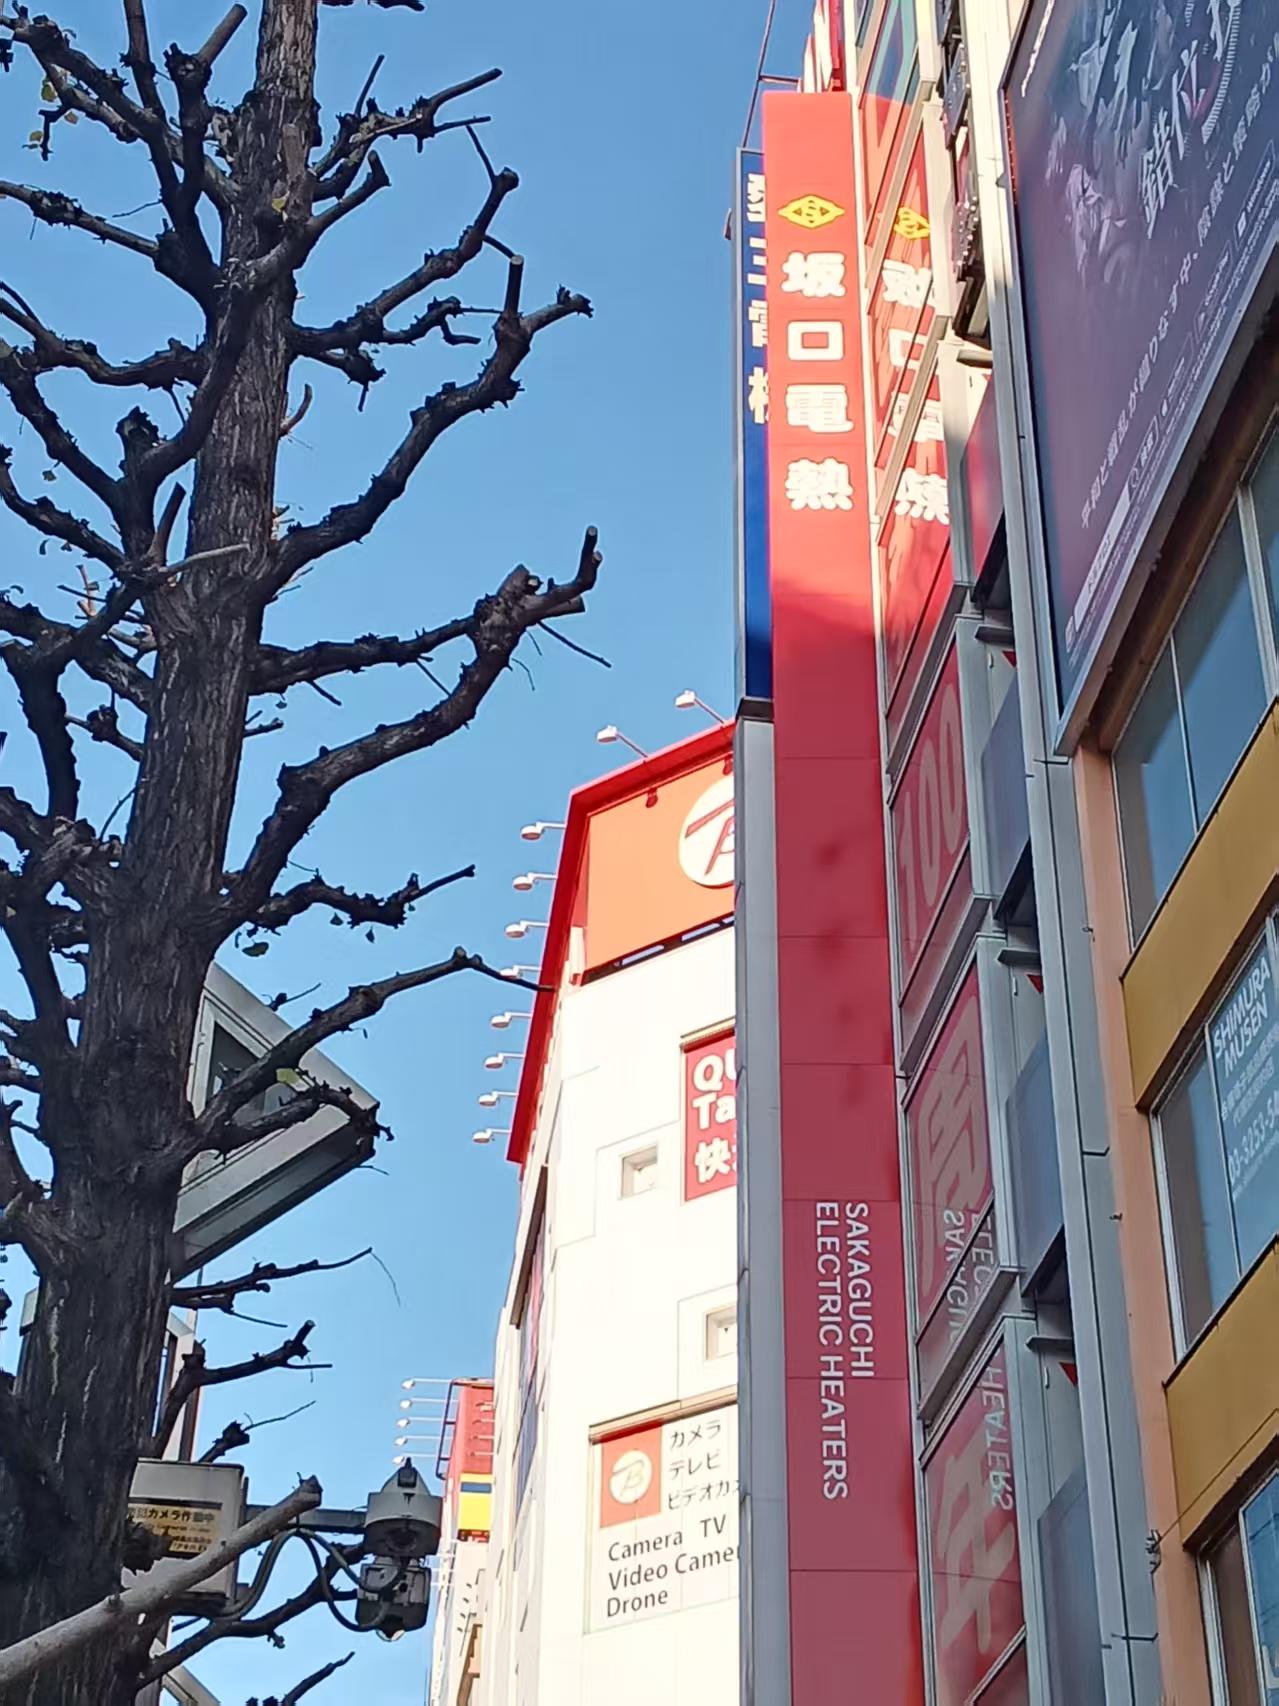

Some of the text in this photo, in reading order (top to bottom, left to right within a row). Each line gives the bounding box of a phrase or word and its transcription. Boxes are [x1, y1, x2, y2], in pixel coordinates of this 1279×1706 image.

[780, 252, 854, 511] 坂口電熱
[1214, 957, 1270, 1059] SHIMURA
[1225, 991, 1268, 1078] MUSEN
[694, 1134, 738, 1184] 快
[845, 1202, 875, 1377] SAKAGUCHI
[815, 1202, 849, 1500] ELECTRIC HEATERS
[670, 1419, 721, 1449] カメラ
[669, 1450, 721, 1480] テレビ
[608, 1514, 726, 1561] Camera TV
[608, 1564, 668, 1591] Video
[607, 1590, 668, 1618] Drone
